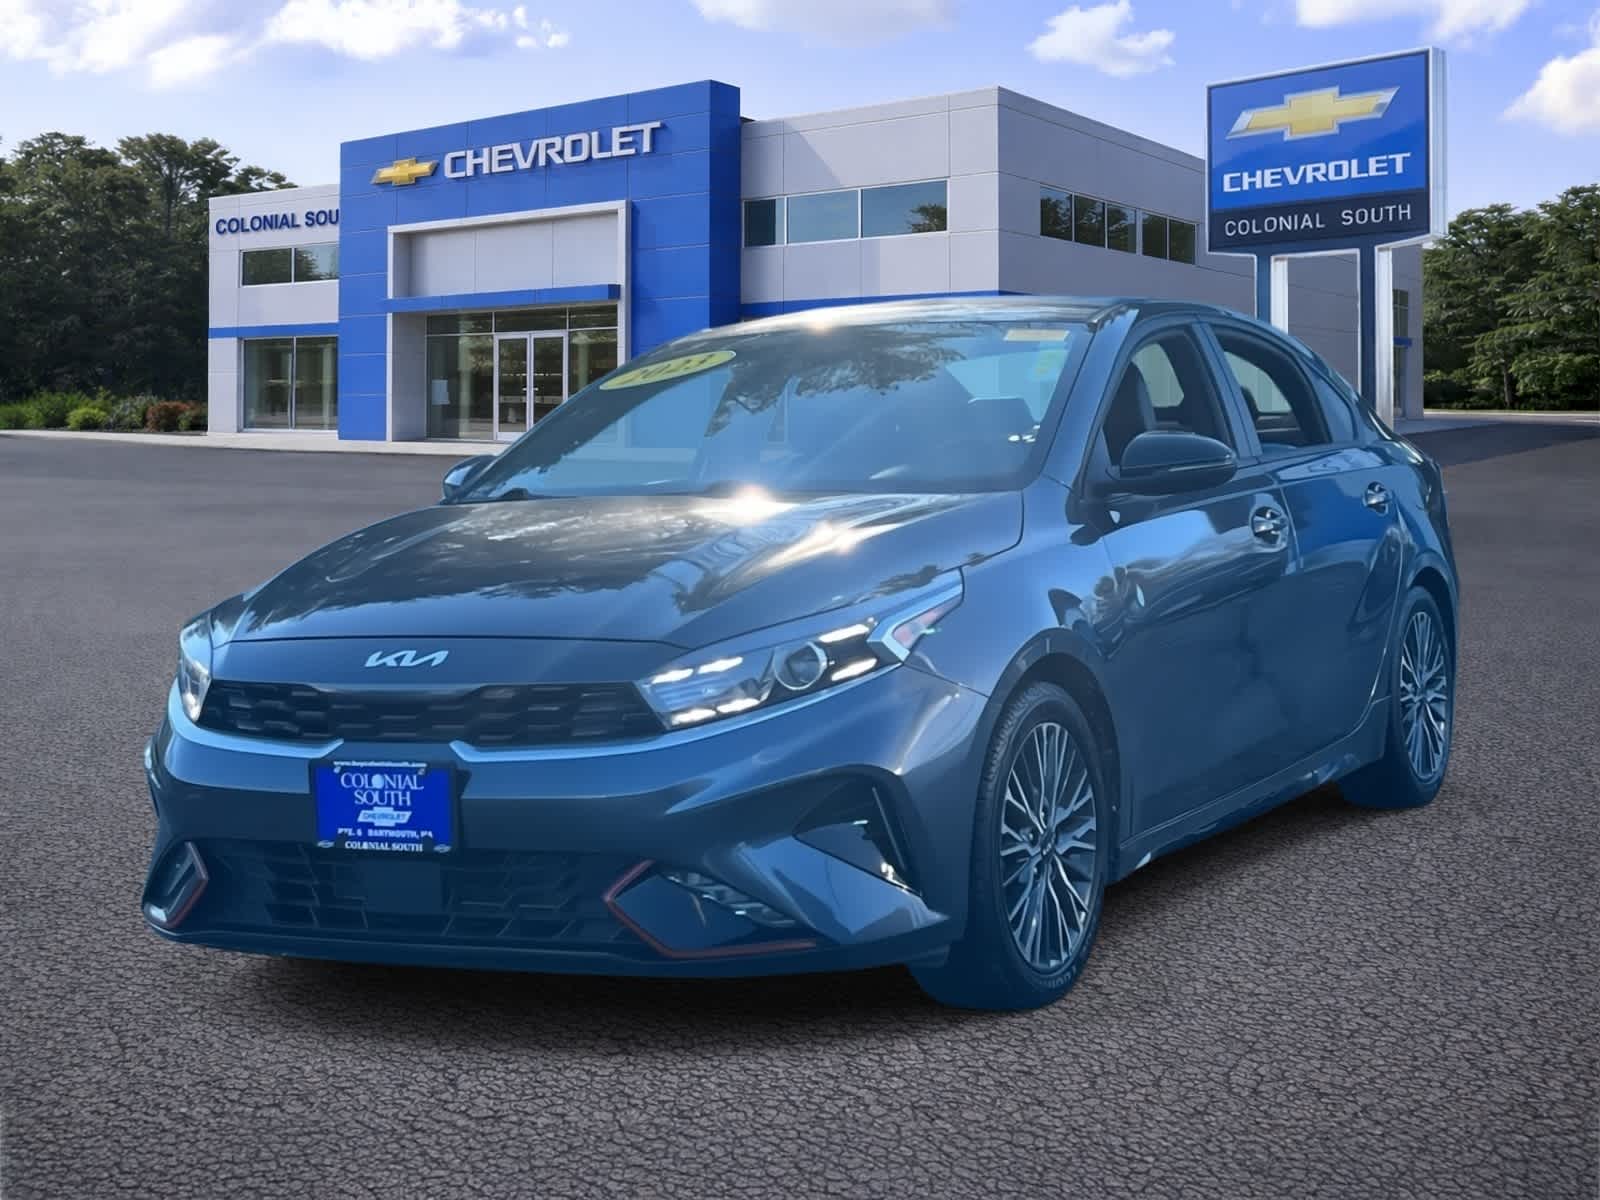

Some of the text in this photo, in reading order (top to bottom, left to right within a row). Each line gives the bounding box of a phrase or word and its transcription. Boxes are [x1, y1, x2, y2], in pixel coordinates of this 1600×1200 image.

[444, 120, 662, 179] CHEVROLET
[1222, 152, 1412, 193] CHEVROLET
[215, 212, 301, 235] COLONIAL
[1224, 203, 1412, 237] COLONIAL SOUTH
[364, 650, 449, 668] KIA
[340, 773, 424, 790] COLONIAL
[354, 790, 412, 806] SOUTH
[345, 841, 423, 852] COLONIAL SOUTH
